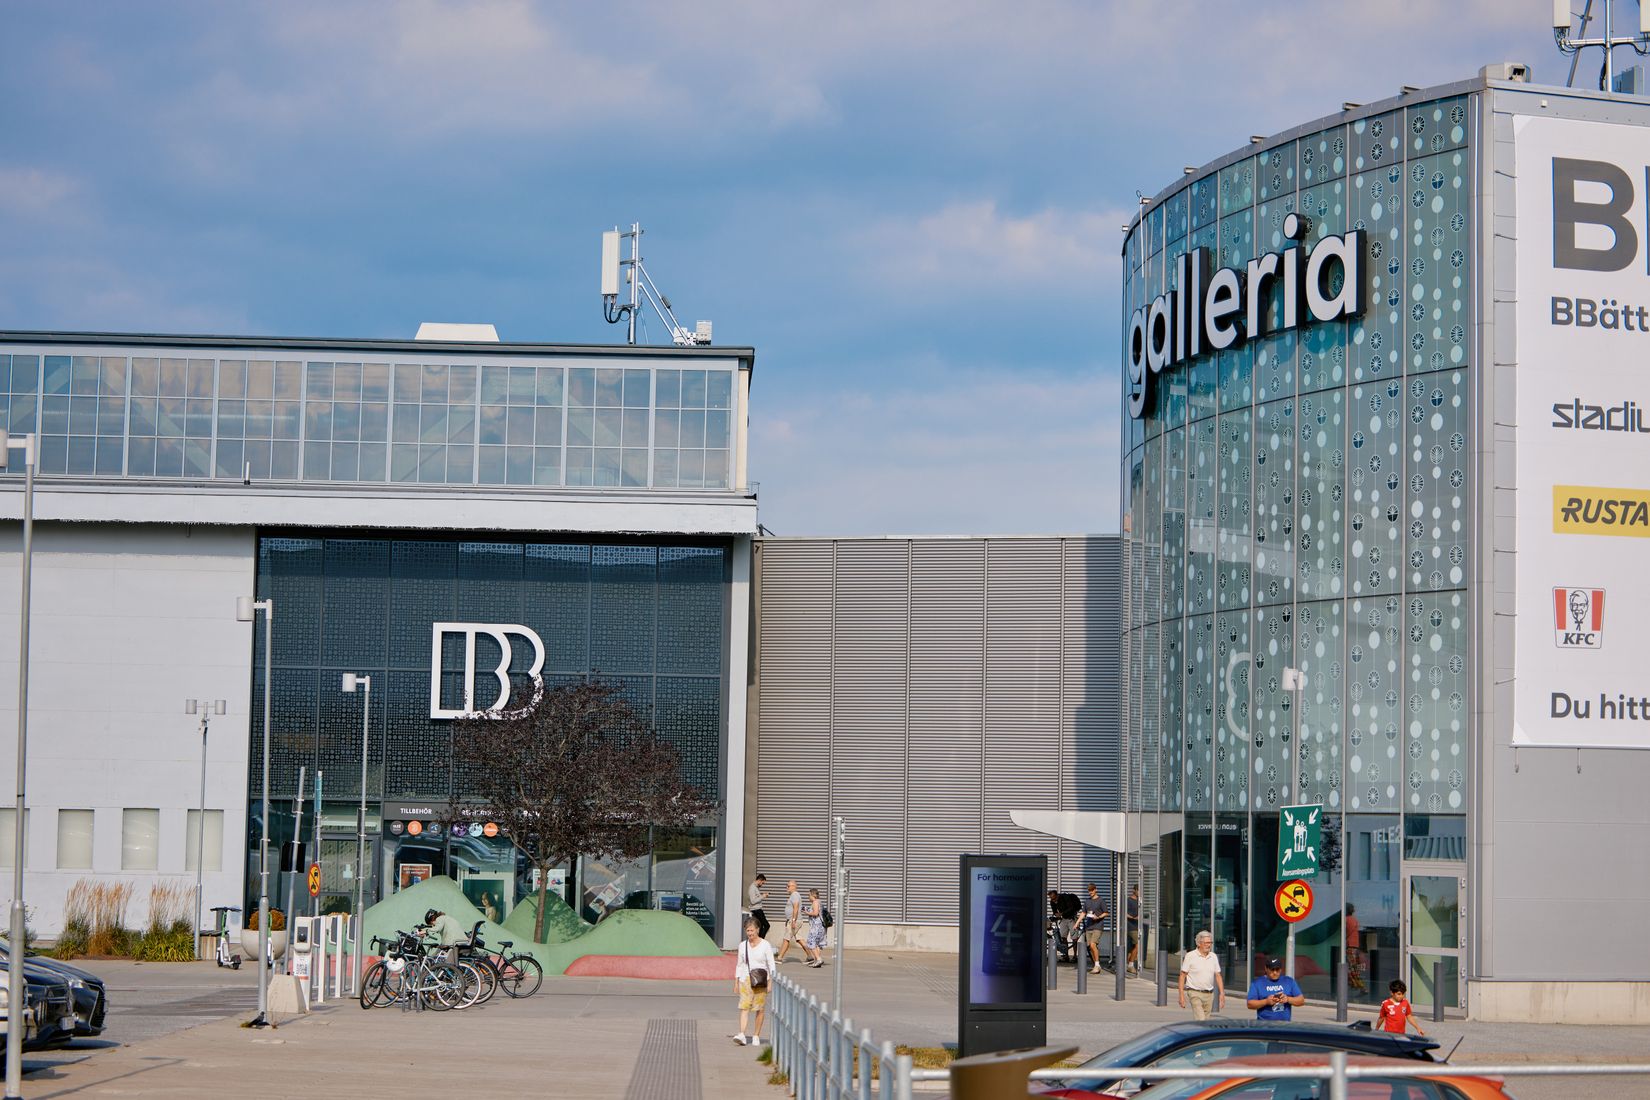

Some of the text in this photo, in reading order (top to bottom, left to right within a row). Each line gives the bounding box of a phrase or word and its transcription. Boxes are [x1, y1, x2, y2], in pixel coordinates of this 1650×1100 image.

[1551, 156, 1650, 276] B
[1128, 212, 1366, 419] galleria
[1563, 632, 1595, 645] KFC
[1551, 692, 1650, 720] Du hitt
[400, 807, 432, 815] TILLBEHÖR
